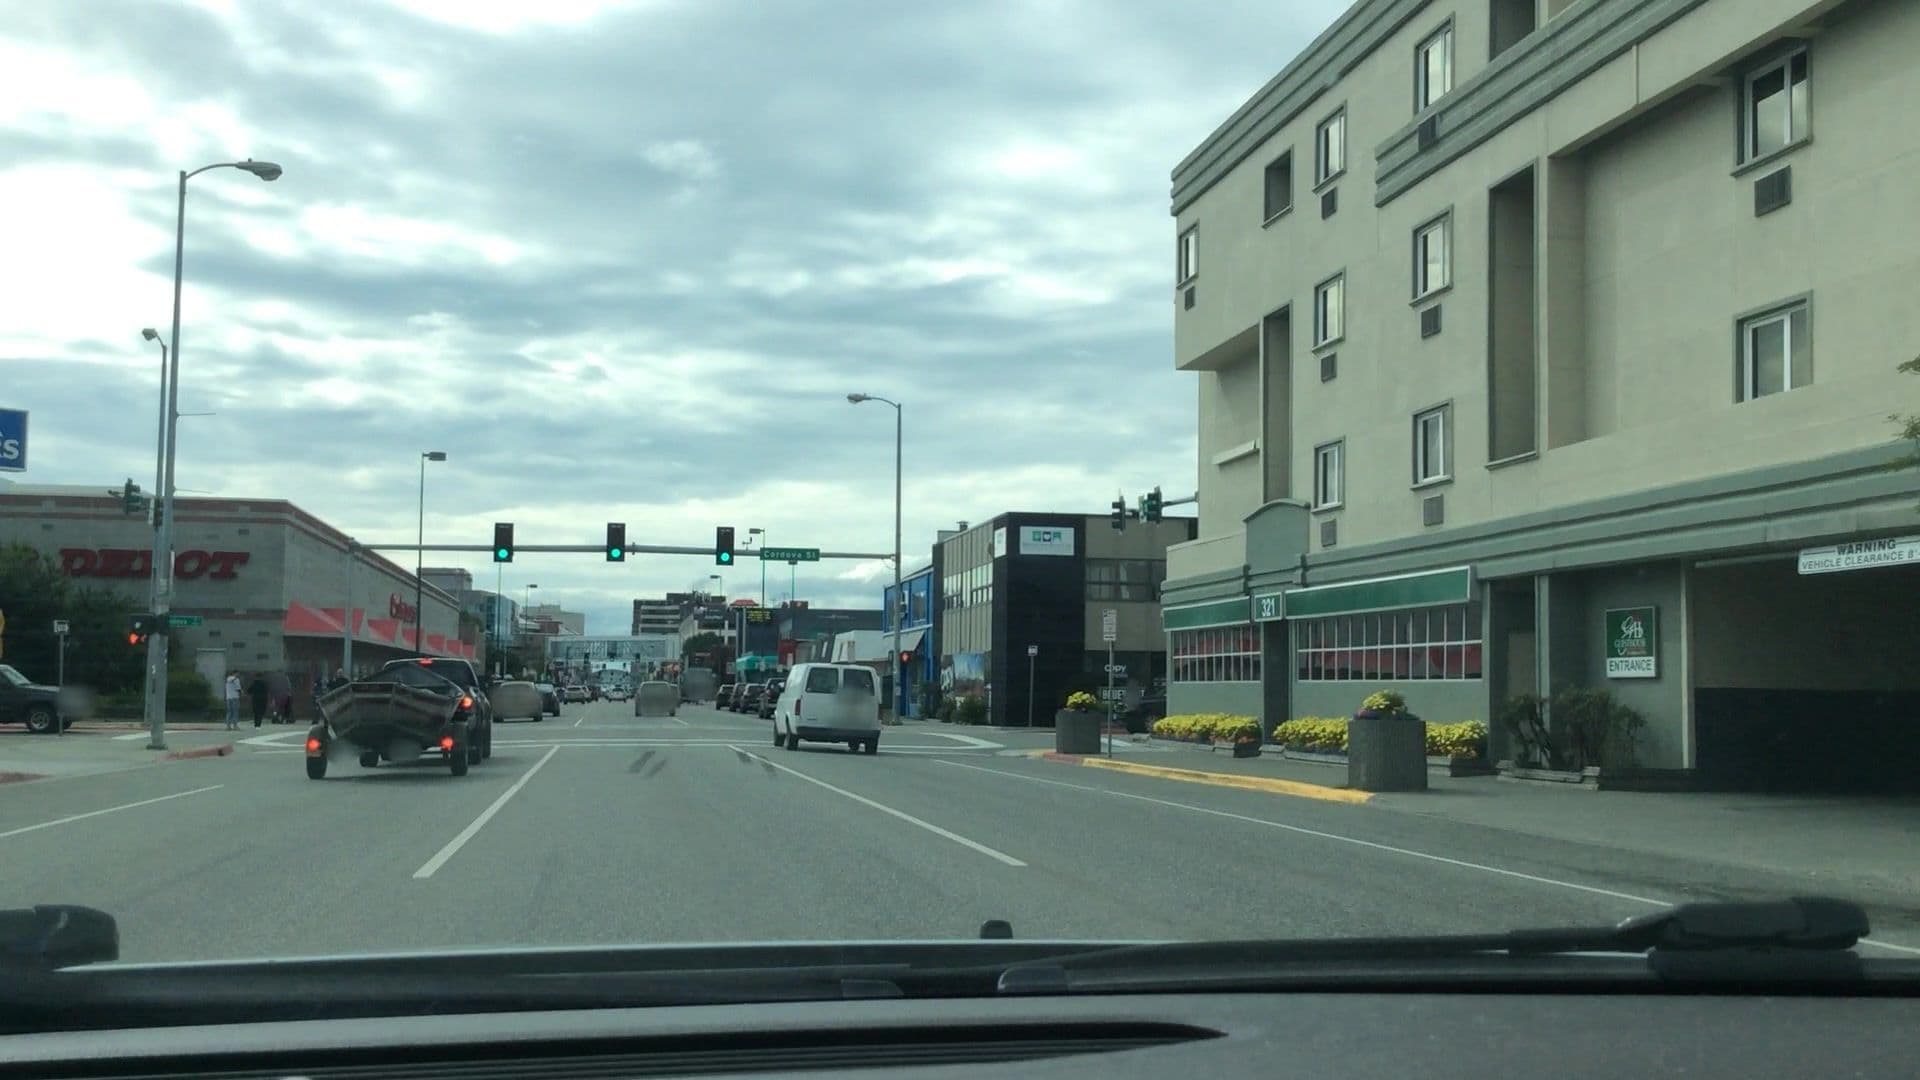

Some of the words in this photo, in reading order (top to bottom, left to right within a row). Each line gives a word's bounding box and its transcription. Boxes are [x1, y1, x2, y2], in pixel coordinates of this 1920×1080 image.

[763, 550, 803, 559] Cordova
[1836, 539, 1896, 555] WARNING
[1802, 559, 1841, 569] VEHICLE
[1844, 551, 1904, 564] CLEARANCE
[1261, 598, 1276, 616] 321
[1609, 659, 1653, 672] ENTRANCE
